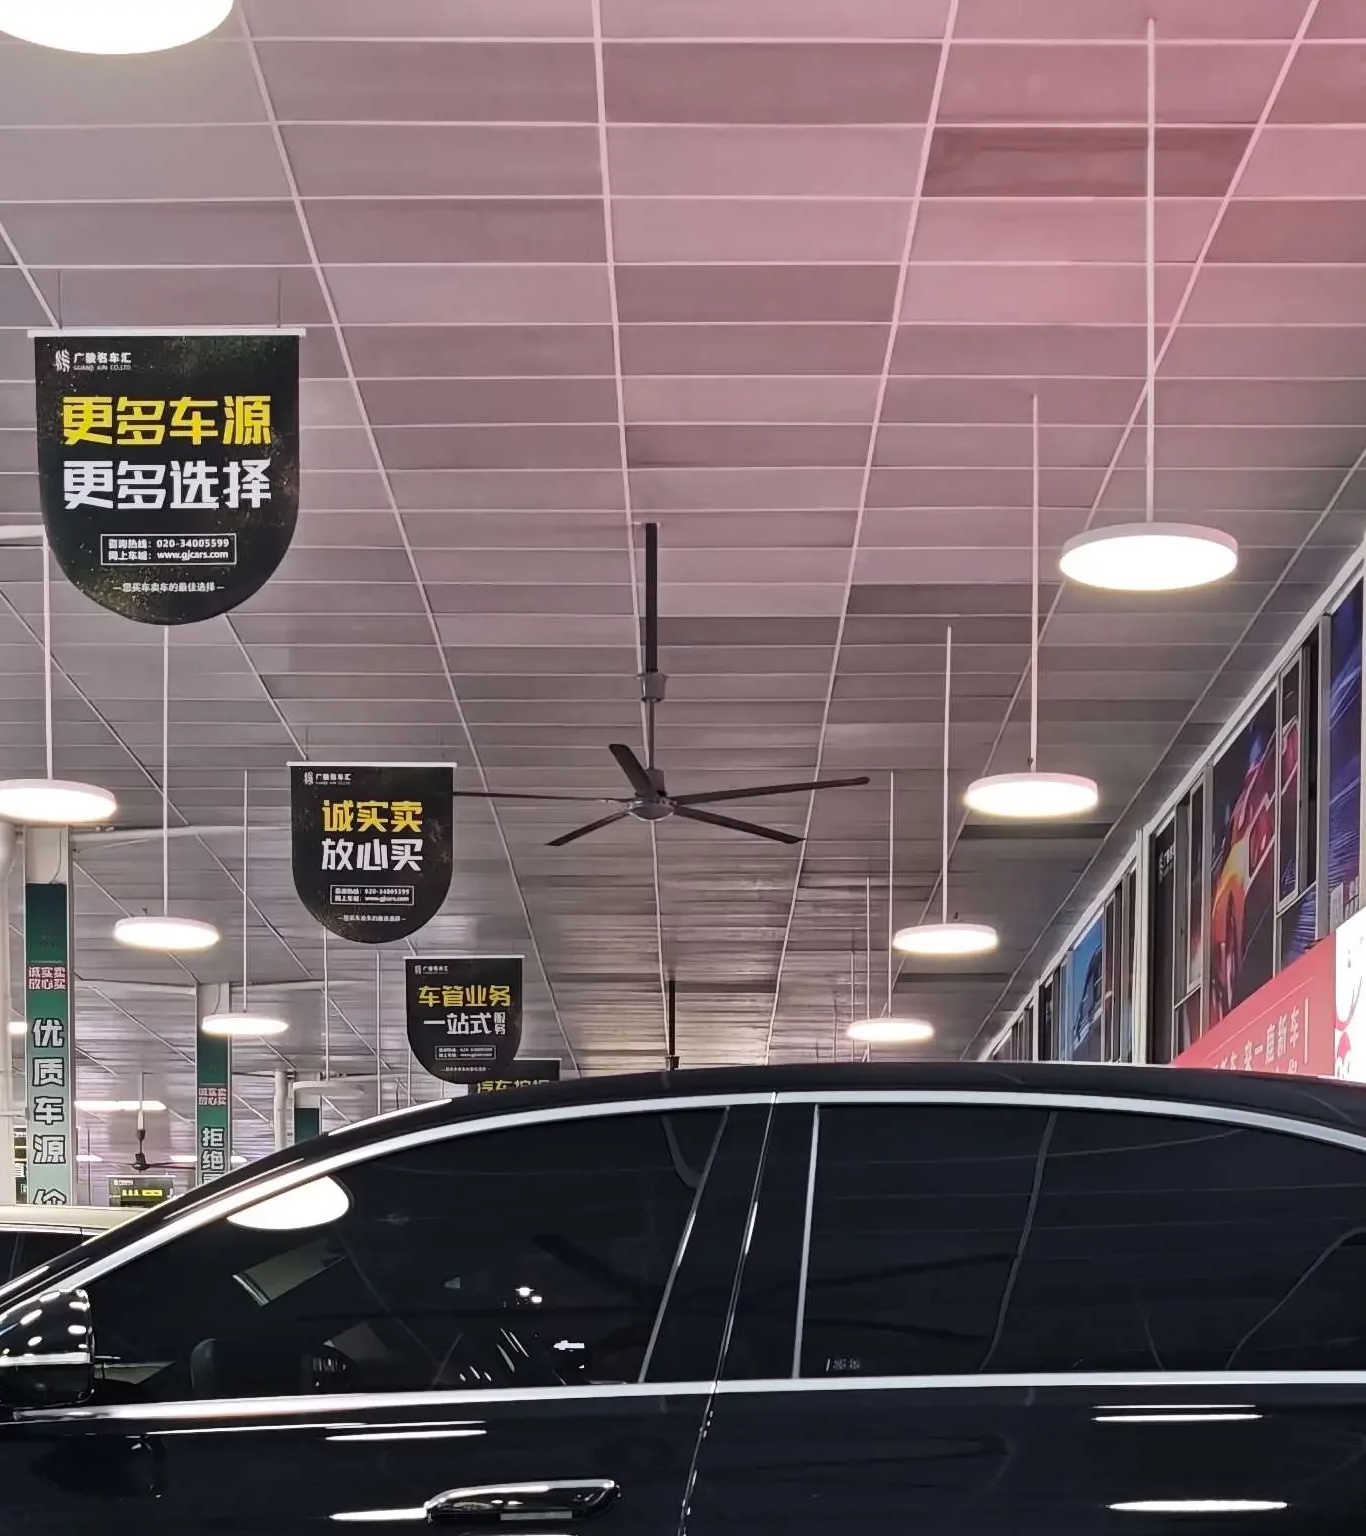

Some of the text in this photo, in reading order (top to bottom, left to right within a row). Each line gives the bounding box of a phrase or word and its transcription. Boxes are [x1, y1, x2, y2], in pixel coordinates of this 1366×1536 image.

[63, 396, 272, 445] 更多车源
[63, 459, 272, 509] 更多选择
[322, 800, 423, 832] 诚实卖
[322, 838, 423, 871] 放心买
[418, 985, 512, 1007] 车管业务
[32, 1018, 66, 1165] 优质车源
